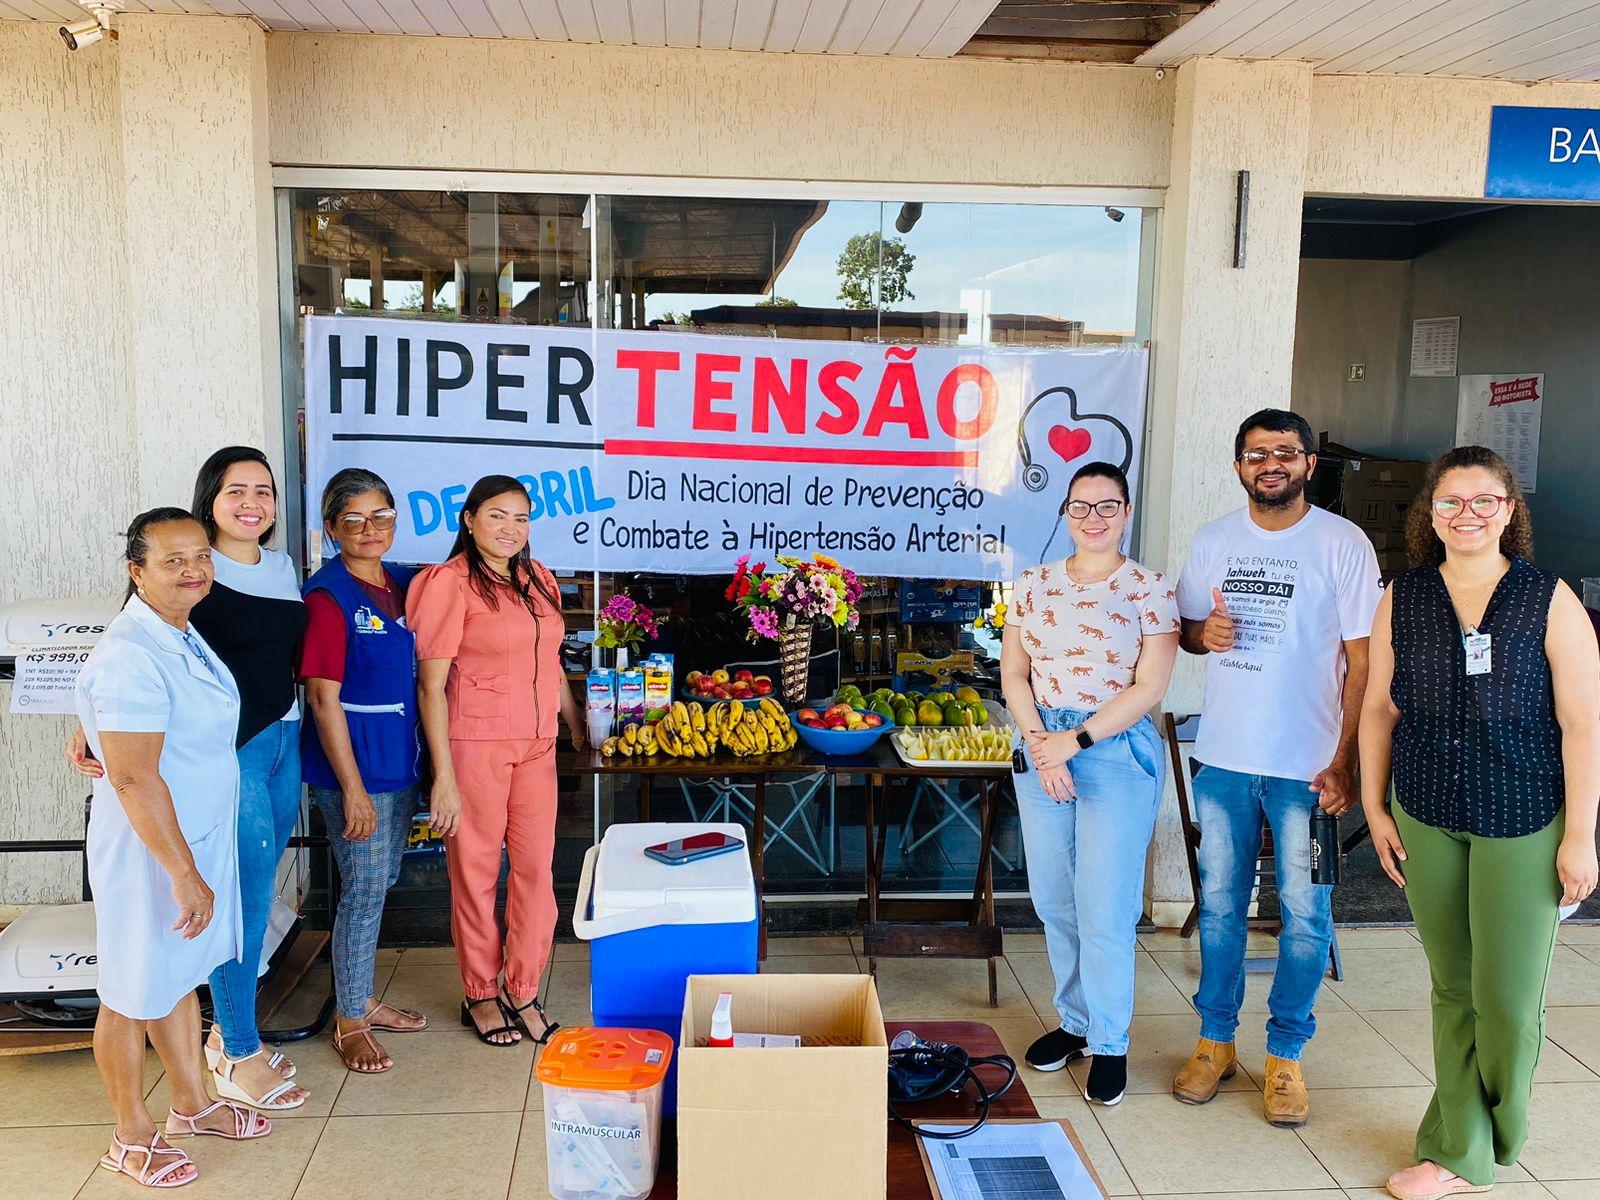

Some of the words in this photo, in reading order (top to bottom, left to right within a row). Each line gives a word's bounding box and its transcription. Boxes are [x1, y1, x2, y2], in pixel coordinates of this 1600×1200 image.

[1548, 127, 1600, 164] BA
[328, 334, 595, 426] HIPER
[616, 345, 998, 441] TENSÃO
[407, 484, 467, 537] DE
[515, 465, 616, 522] BRIL
[628, 470, 666, 501] Dia
[681, 472, 791, 506] Nacional
[804, 476, 834, 507] de
[844, 477, 984, 516] Prevenção
[573, 521, 590, 545] e
[600, 516, 709, 550] Combate
[721, 519, 739, 551] à
[749, 520, 896, 558] Hipertensão
[905, 522, 1006, 554] Arterial
[1236, 557, 1250, 566] NO
[1251, 557, 1299, 570] ENTANTO,
[1271, 572, 1281, 580] tu
[1283, 573, 1295, 582] és
[1223, 582, 1264, 593] NOSSO
[26, 653, 46, 664] R$
[551, 1120, 642, 1140] INTRAMUSCULAR
